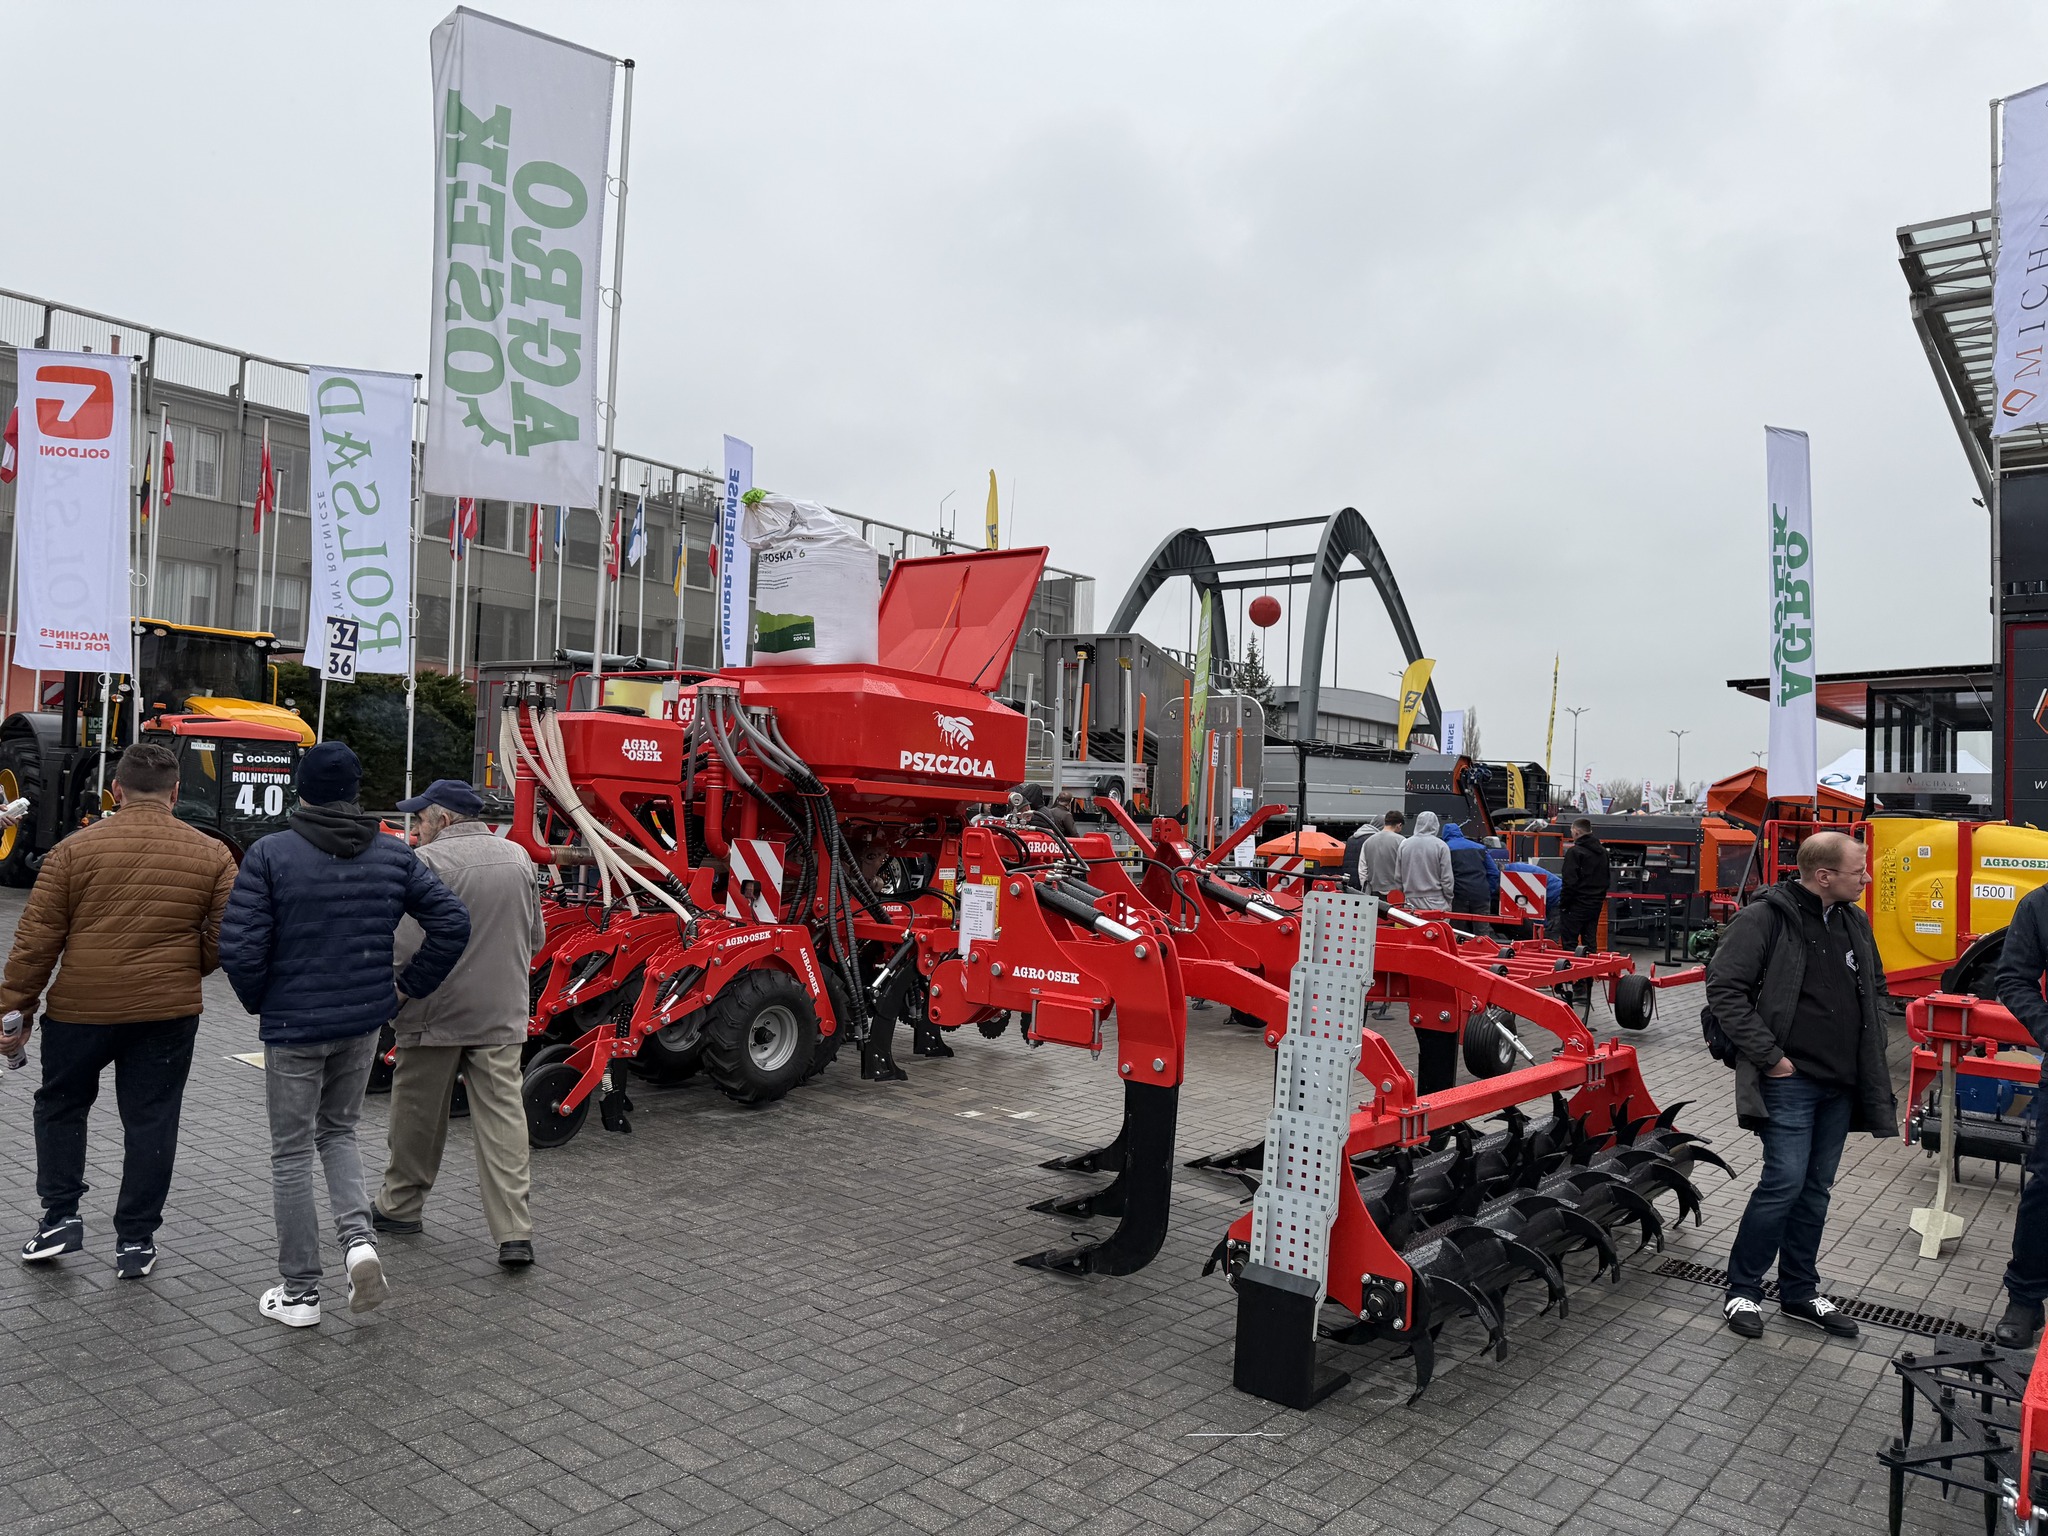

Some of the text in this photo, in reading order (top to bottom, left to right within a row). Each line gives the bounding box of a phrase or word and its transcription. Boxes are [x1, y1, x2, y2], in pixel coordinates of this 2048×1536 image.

[328, 652, 352, 676] 36
[622, 738, 658, 751] AGRO
[246, 755, 291, 764] GOLDONI
[628, 750, 662, 762] OSEK
[899, 750, 996, 778] PSZCZOŁA
[232, 771, 291, 785] ROLNICTWO
[235, 784, 284, 816] 4.0
[1984, 858, 2048, 869] AGRO-OSE
[1975, 886, 2006, 898] 1500
[725, 930, 772, 947] AGRO-OSEK
[799, 947, 821, 997] AGRO-OSEK
[1012, 966, 1080, 985] AGRO-OSEK
